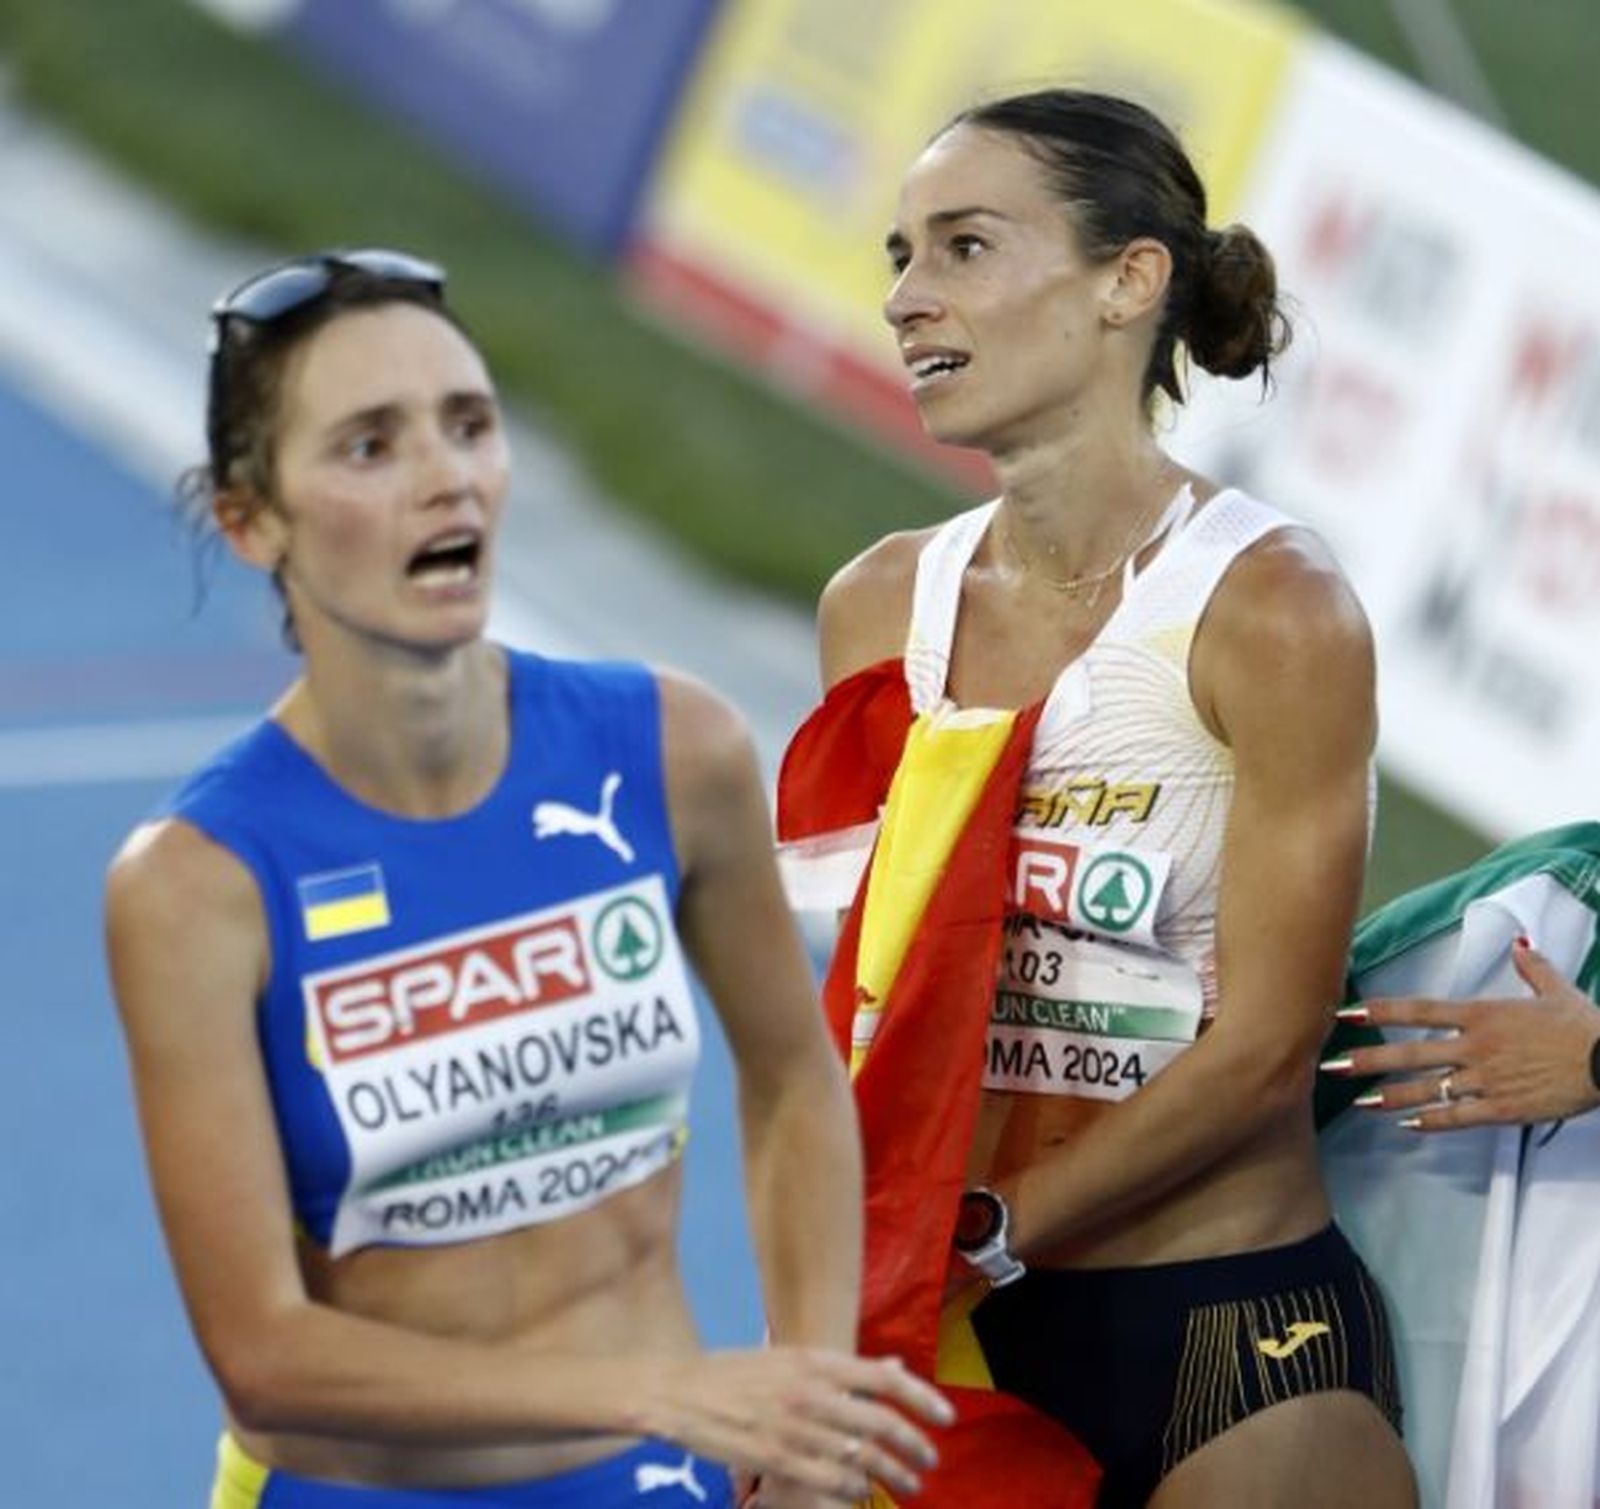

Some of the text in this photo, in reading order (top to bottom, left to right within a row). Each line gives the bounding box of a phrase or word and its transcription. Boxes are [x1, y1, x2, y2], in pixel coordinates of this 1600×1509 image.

[325, 926, 586, 1051] SPAR
[992, 995, 1027, 1021] UN
[346, 996, 684, 1130] OLYANOVSKA
[988, 1038, 1147, 1087] MA 2024
[382, 1178, 527, 1229] ROMA
